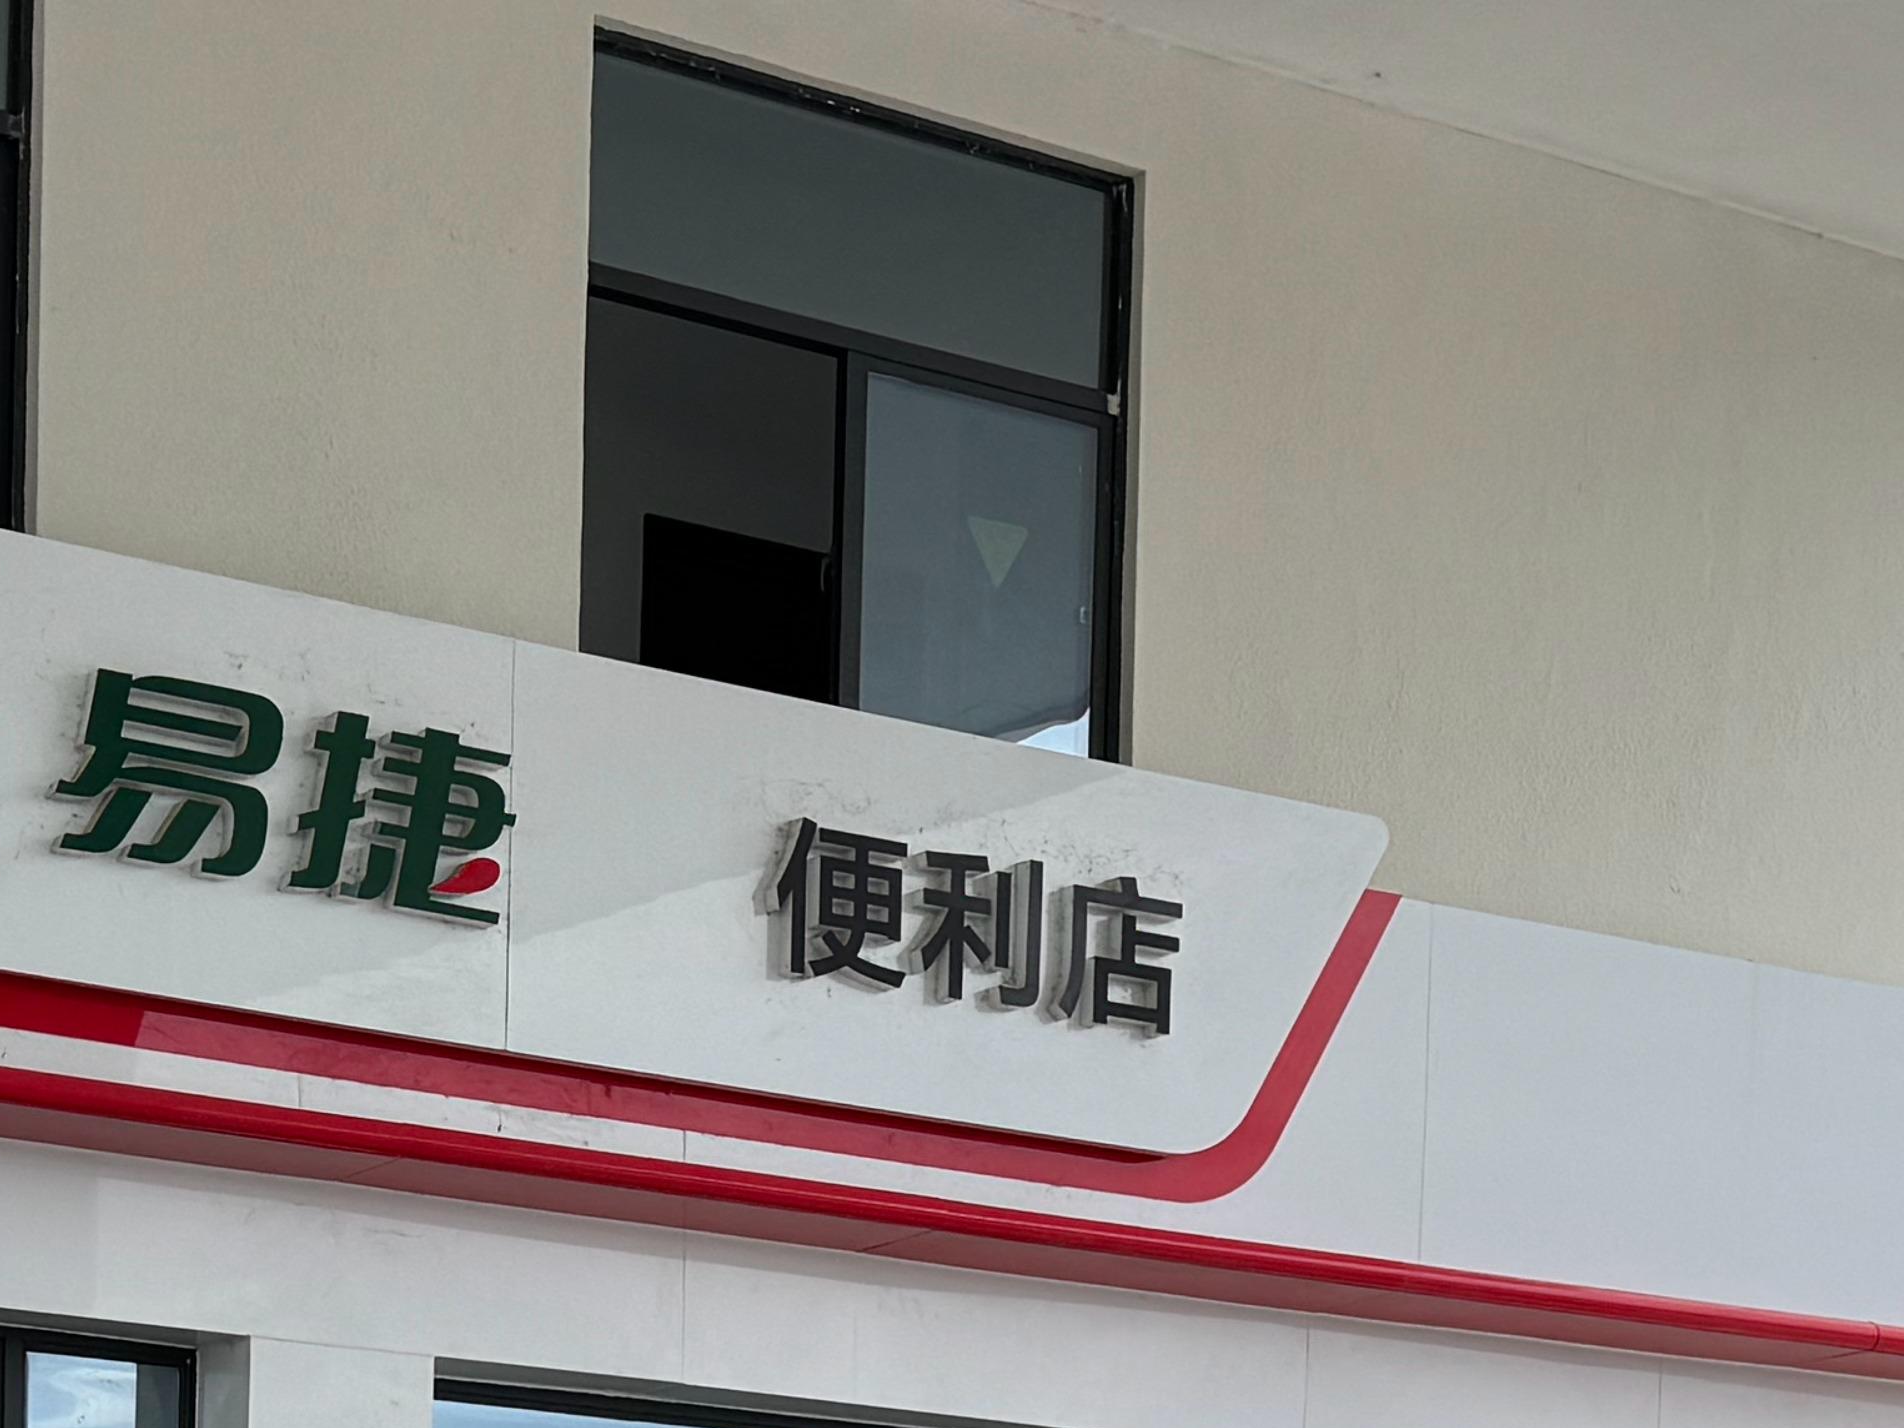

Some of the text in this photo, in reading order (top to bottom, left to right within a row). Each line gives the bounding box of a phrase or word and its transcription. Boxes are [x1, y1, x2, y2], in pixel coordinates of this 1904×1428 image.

[52, 667, 1185, 1038] 易捷 便利店
